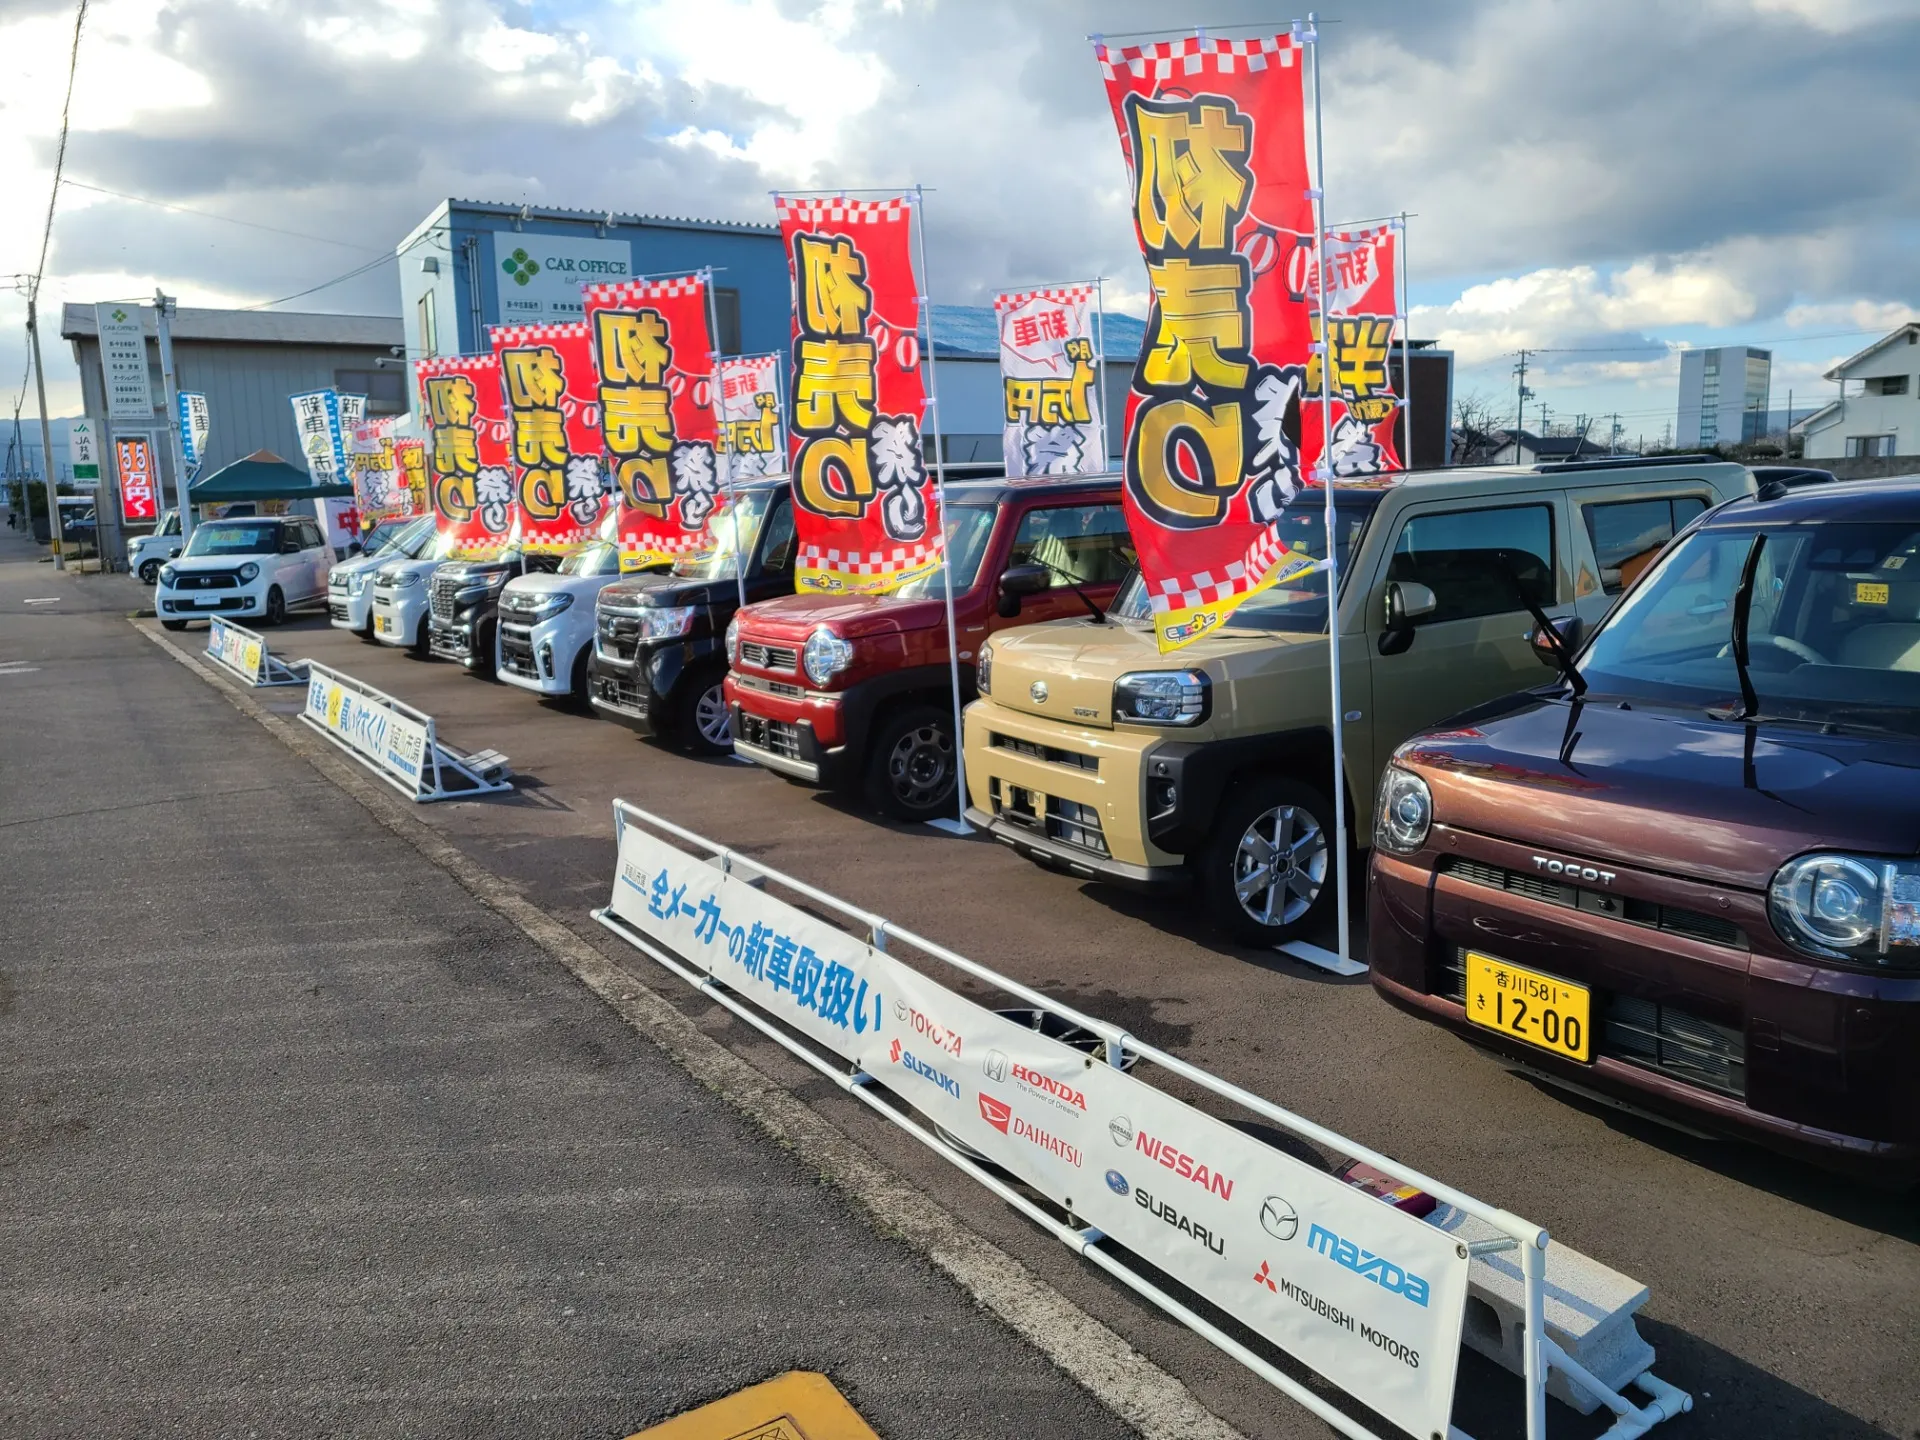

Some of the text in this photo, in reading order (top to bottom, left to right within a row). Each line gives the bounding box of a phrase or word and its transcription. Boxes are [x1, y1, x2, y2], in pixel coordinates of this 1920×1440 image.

[545, 257, 627, 275] CAR OFFICE
[1532, 856, 1617, 886] TOCOT
[648, 868, 883, 1035] 全メーカーの新車取扱い
[1477, 992, 1486, 1010] き
[1496, 992, 1582, 1052] 12-00
[910, 1008, 962, 1058] TOYOTA
[903, 1051, 960, 1100] SUZUKI
[1011, 1063, 1087, 1111] HONDA
[1016, 1081, 1080, 1118] The Power of Dreams
[1014, 1117, 1083, 1169] DAIHATSU
[1136, 1132, 1234, 1202] NISSAN
[1135, 1188, 1225, 1257] SUBARU
[1281, 1279, 1420, 1369] MITSUBISHI MOTORS
